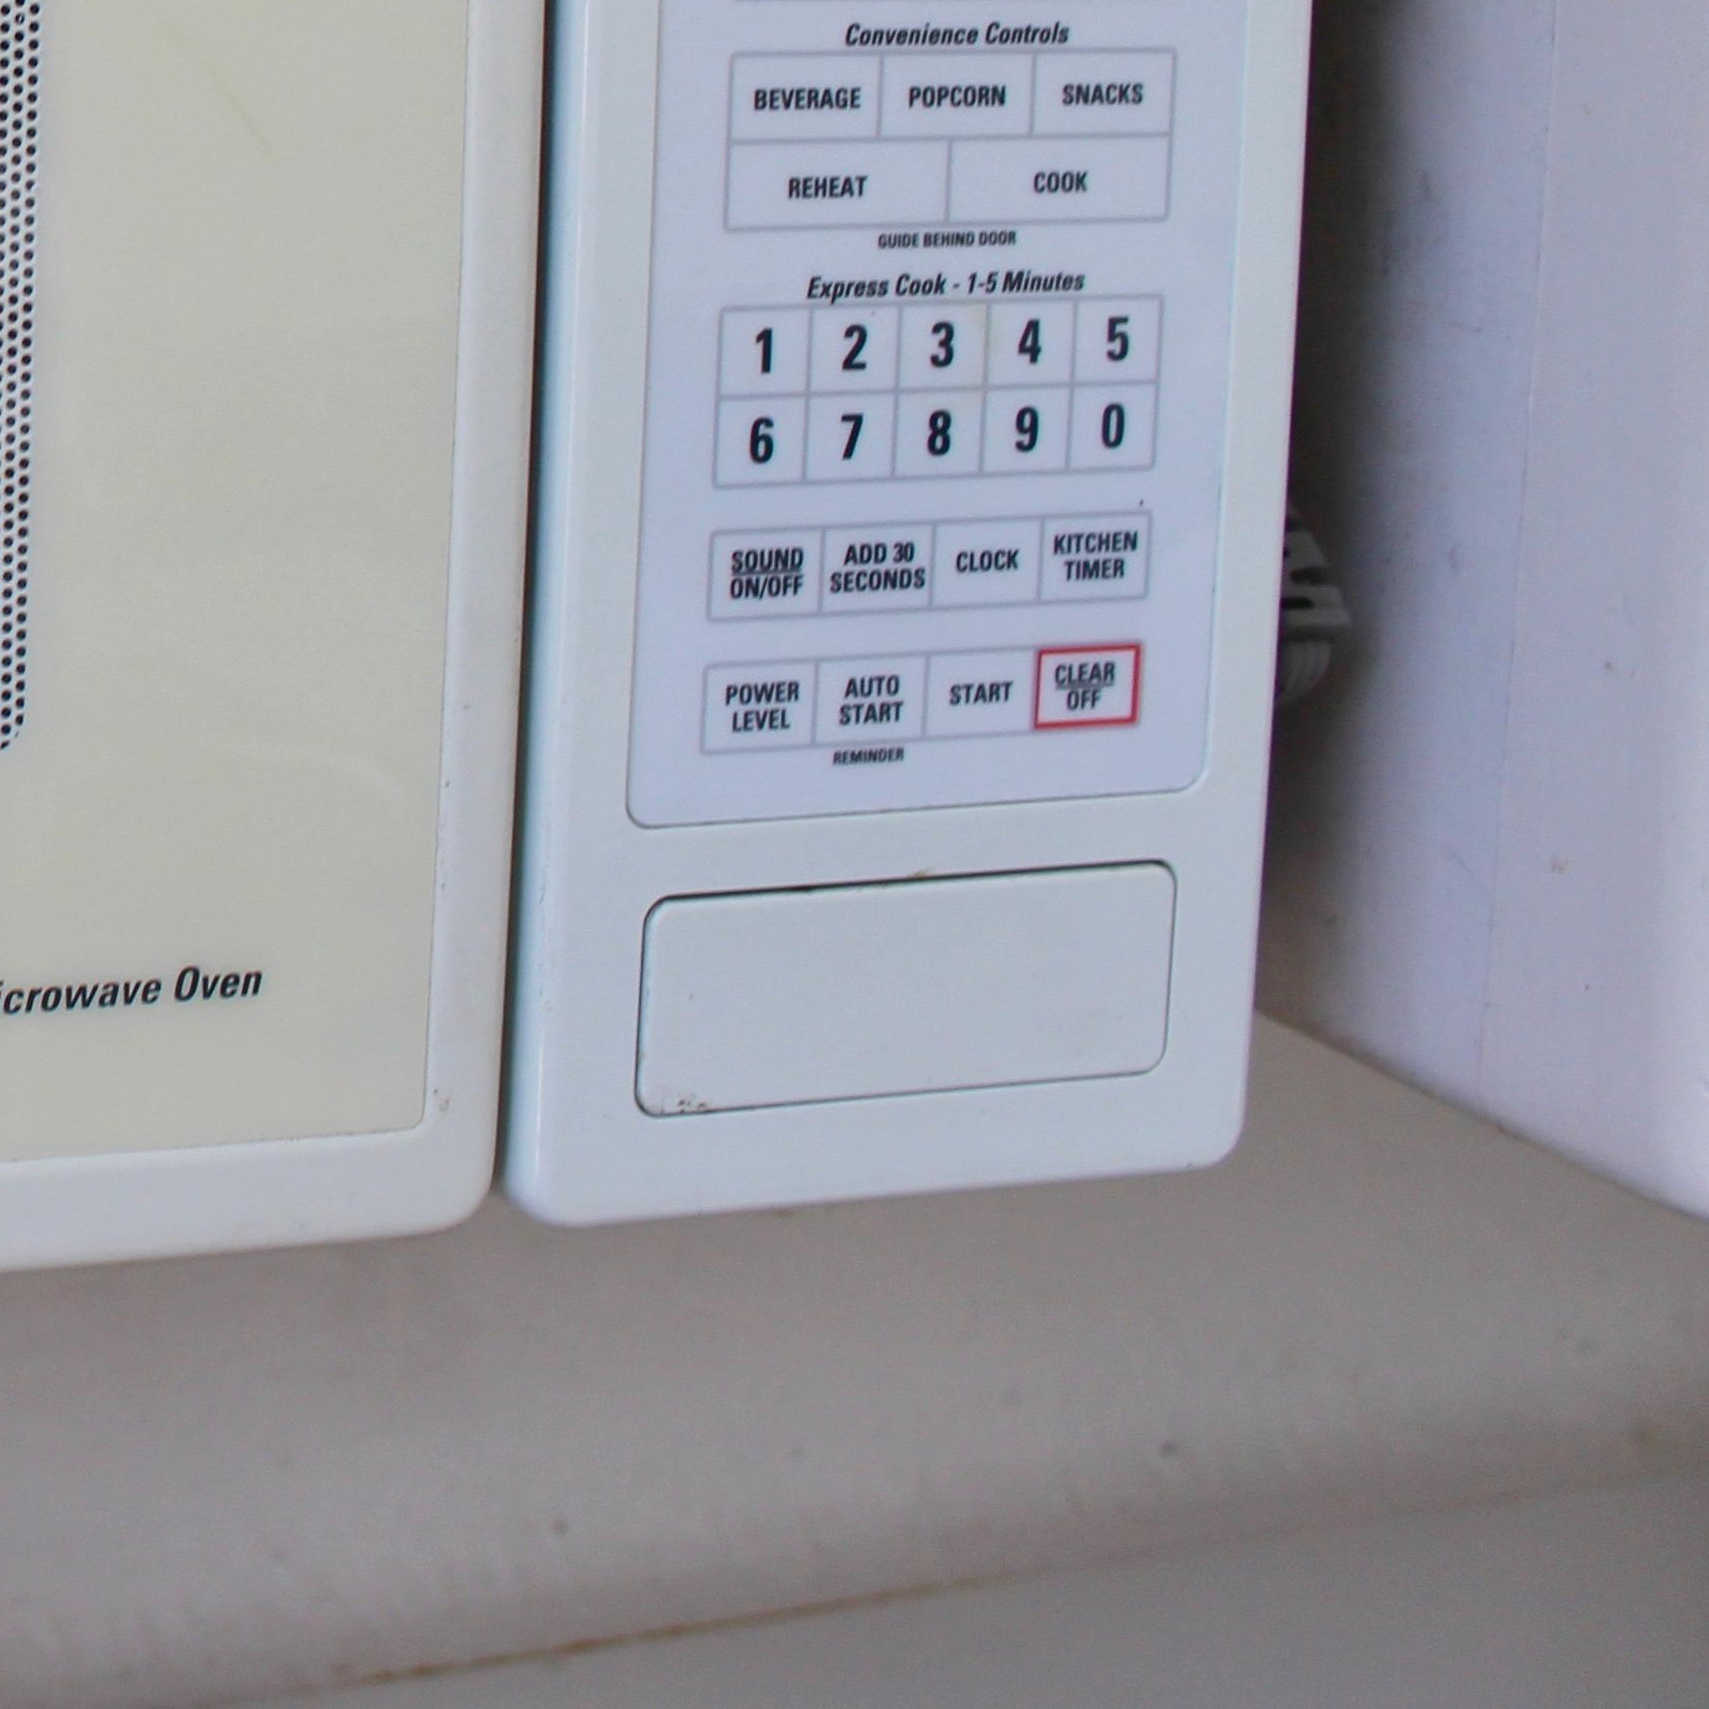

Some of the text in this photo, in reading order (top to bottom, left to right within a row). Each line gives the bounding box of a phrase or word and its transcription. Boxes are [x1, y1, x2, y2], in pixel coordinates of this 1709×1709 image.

[845, 21, 1070, 46] Convenience Controls
[754, 87, 861, 110] BEVERAGE
[908, 85, 1006, 108] POPCORN
[1062, 83, 1144, 105] SNACKS
[787, 176, 867, 199] REHEAT
[1033, 172, 1088, 193] COOK
[878, 230, 1016, 249] GUIDE BEHIND DOOR
[807, 277, 889, 305] Express
[895, 273, 947, 296] Cook
[966, 272, 998, 294] 1-5
[1002, 269, 1086, 293] Minutes
[755, 328, 774, 374] 1
[841, 325, 869, 372] 2
[930, 321, 956, 368] 3
[1018, 318, 1042, 364] 4
[1106, 316, 1130, 362] 5
[840, 413, 864, 460] 7
[927, 409, 952, 457] 8
[1015, 406, 1040, 452] 9
[1101, 403, 1126, 449] 0
[749, 417, 775, 465] 6
[844, 542, 915, 566] ADD 30
[1053, 531, 1138, 555] KITCHEN
[731, 549, 804, 574] SOUND
[955, 549, 1020, 573] CLOCK
[1064, 557, 1126, 581] TIMER
[729, 574, 804, 600] ON/OFF
[829, 568, 926, 593] SECONDS
[1054, 662, 1115, 685] CLEAR
[725, 682, 800, 706] POWER
[844, 675, 900, 698] AUTO
[949, 682, 1013, 705] START
[1067, 688, 1102, 711] OFF
[732, 709, 790, 732] LEVEL
[839, 701, 904, 725] START
[833, 747, 905, 765] REMINDER
[174, 965, 263, 1001] Oven
